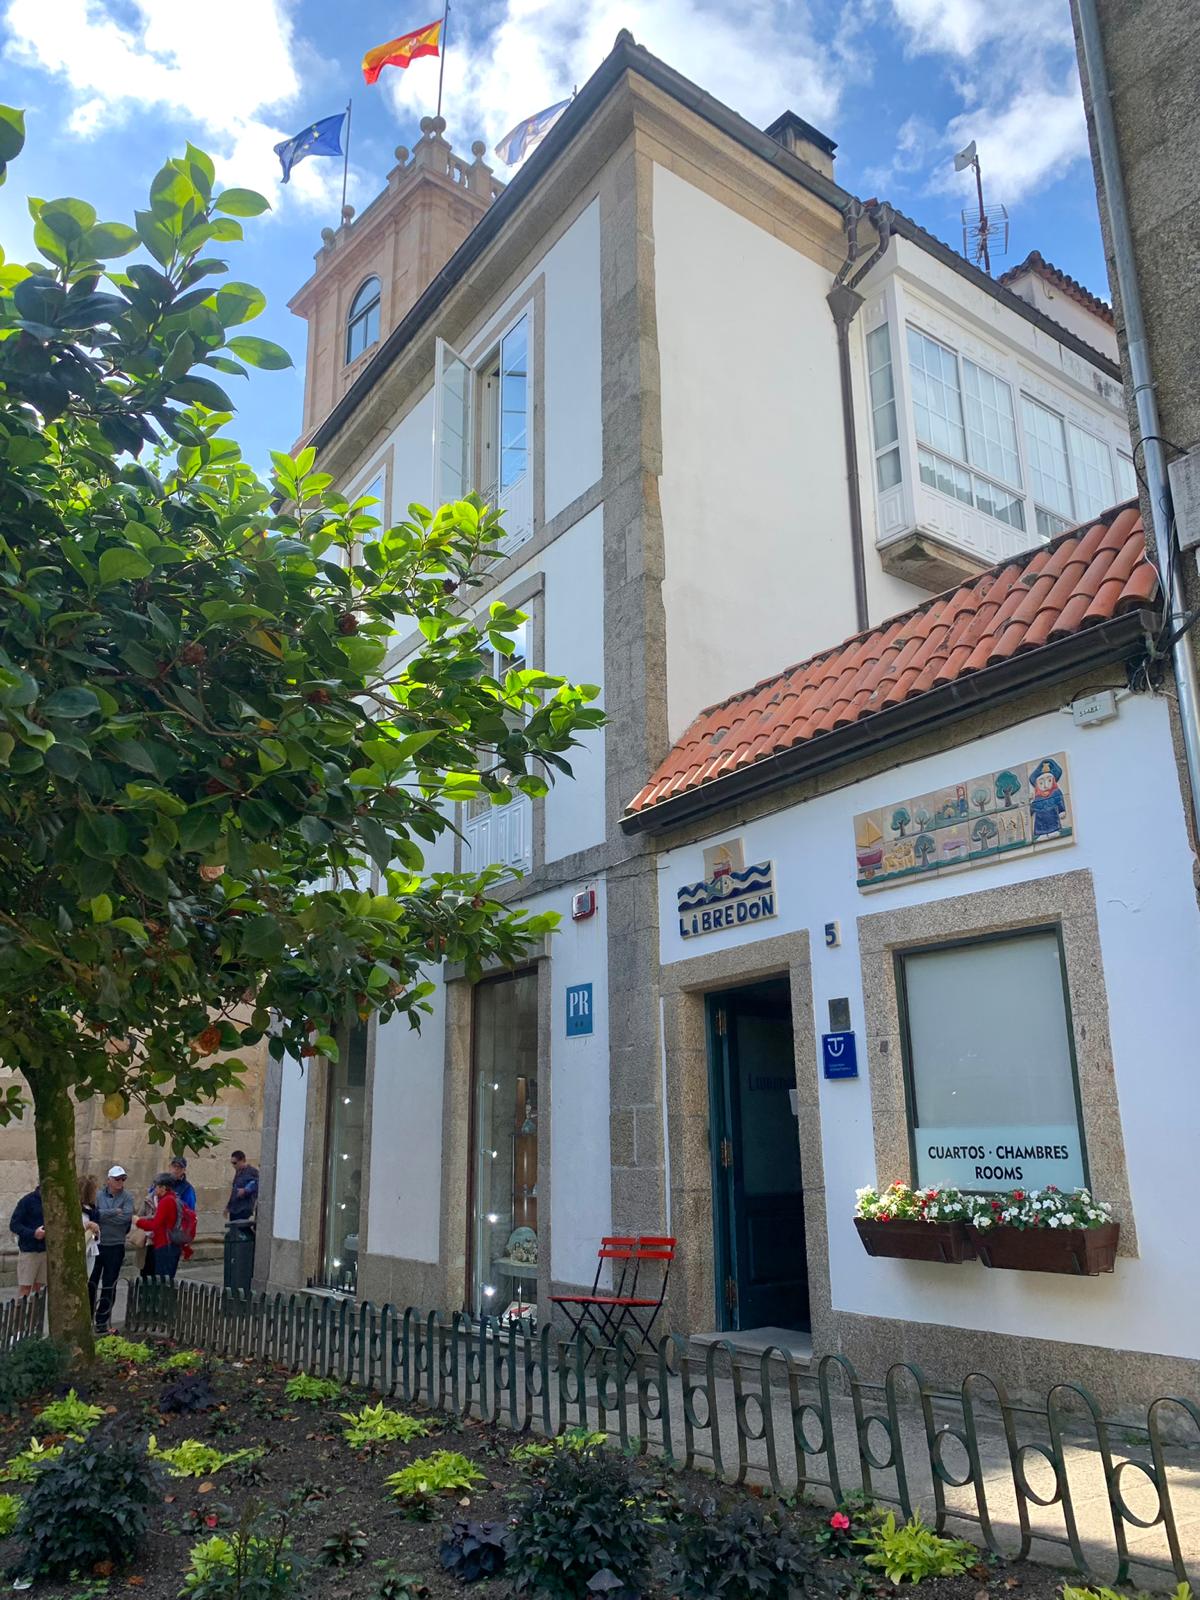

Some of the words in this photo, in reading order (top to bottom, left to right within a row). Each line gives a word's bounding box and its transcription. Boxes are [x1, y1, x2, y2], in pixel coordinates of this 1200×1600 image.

[825, 923, 837, 946] 5
[569, 990, 589, 1017] PR
[928, 1145, 985, 1159] CUARTOS
[996, 1145, 1068, 1159] CHAMBRES
[975, 1166, 1023, 1180] ROOMS
